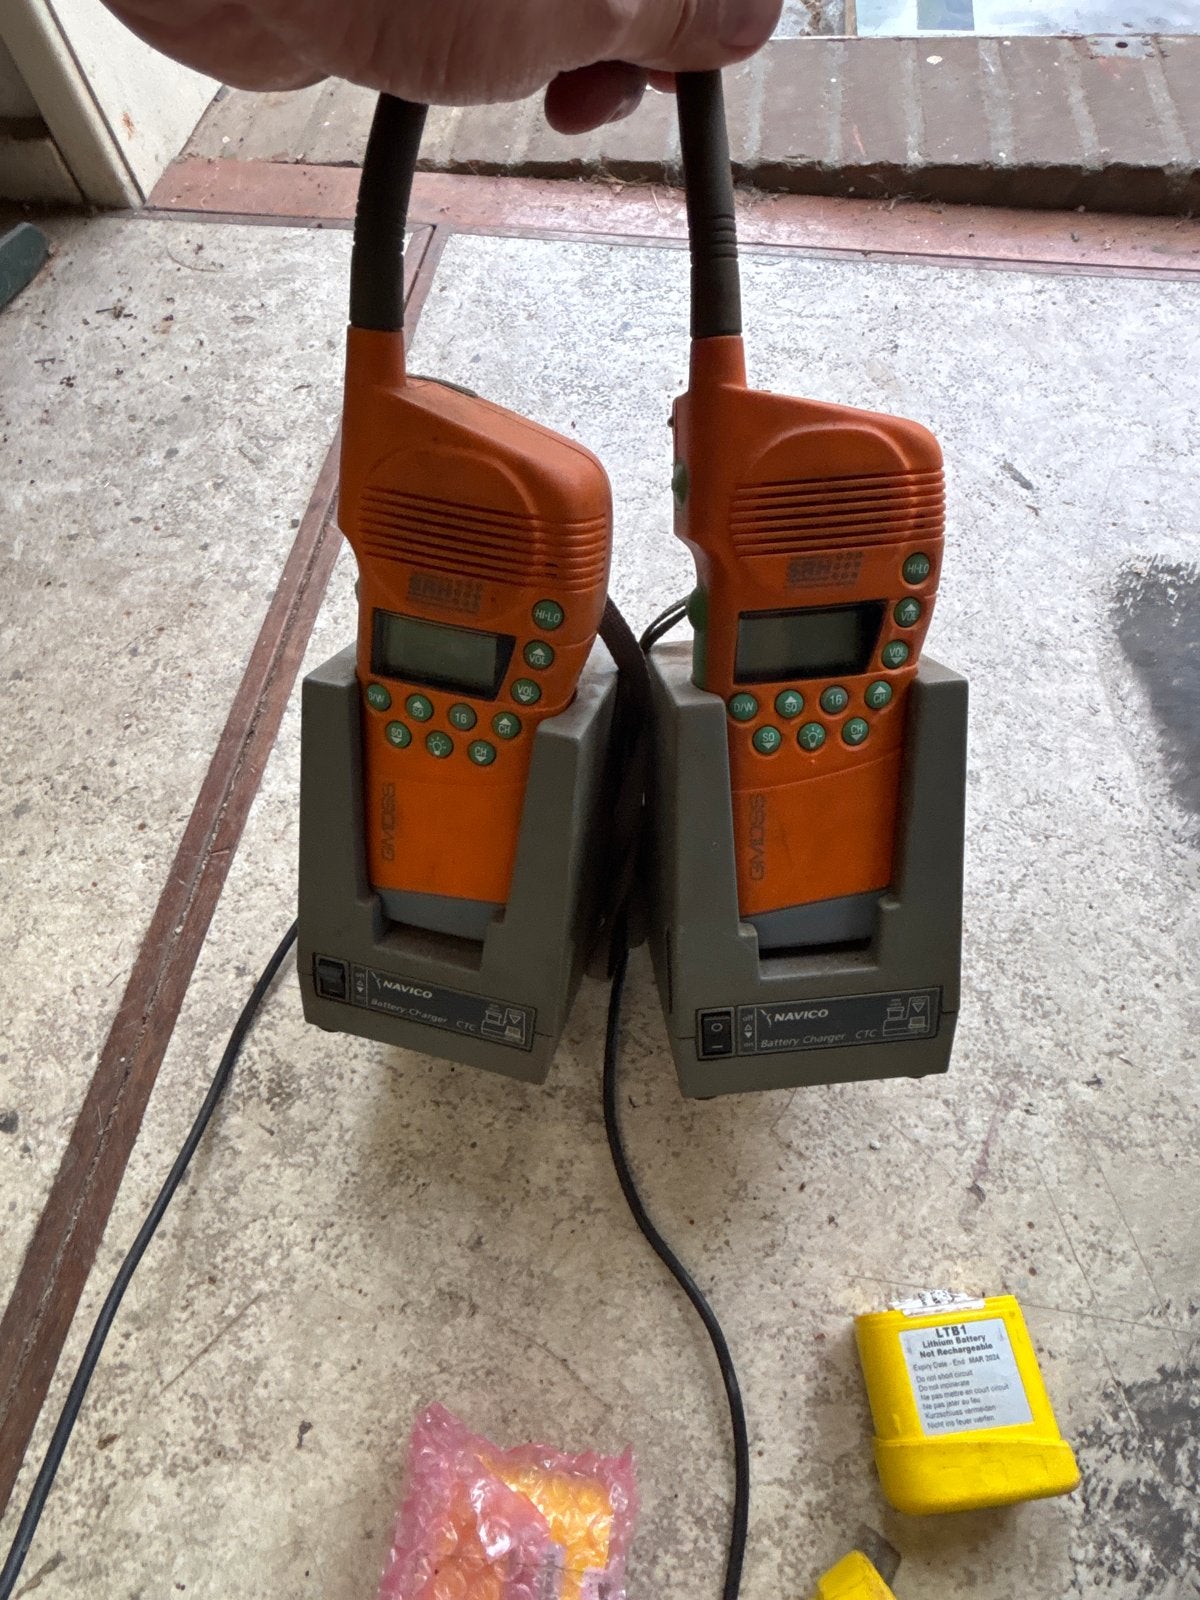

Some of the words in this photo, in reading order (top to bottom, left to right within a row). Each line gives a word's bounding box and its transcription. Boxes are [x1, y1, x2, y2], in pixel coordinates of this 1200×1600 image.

[901, 610, 917, 622] VOL
[889, 646, 905, 658] VOL
[529, 653, 547, 666] VOL
[517, 685, 534, 698] VOL
[829, 694, 843, 705] 16
[873, 693, 887, 704] CH
[733, 702, 754, 713] D/W
[454, 712, 468, 724] 16
[498, 724, 511, 735] CH
[850, 724, 864, 735] CH
[474, 745, 488, 757] CH
[383, 980, 433, 1000] NAVICO
[371, 998, 405, 1014] Battery
[408, 1008, 447, 1024] Charger
[455, 1020, 475, 1032] CTC
[774, 1008, 829, 1022] NAVICO
[760, 1033, 801, 1049] Battery
[803, 1033, 847, 1047] Charger
[855, 1029, 878, 1040] CTC
[935, 1324, 967, 1339] LTB1
[922, 1338, 954, 1349] Lithium
[955, 1334, 986, 1345] Battery
[919, 1349, 935, 1359] Not
[937, 1342, 994, 1356] Rechargeable
[912, 1363, 932, 1372] Expiry
[932, 1360, 948, 1369] Date
[952, 1359, 966, 1367] End
[968, 1356, 984, 1364] MAR
[916, 1375, 926, 1383] Do
[926, 1373, 937, 1381] not
[937, 1372, 953, 1380] short
[918, 1384, 928, 1392] Do
[928, 1383, 939, 1391] not
[931, 1393, 943, 1401] pas
